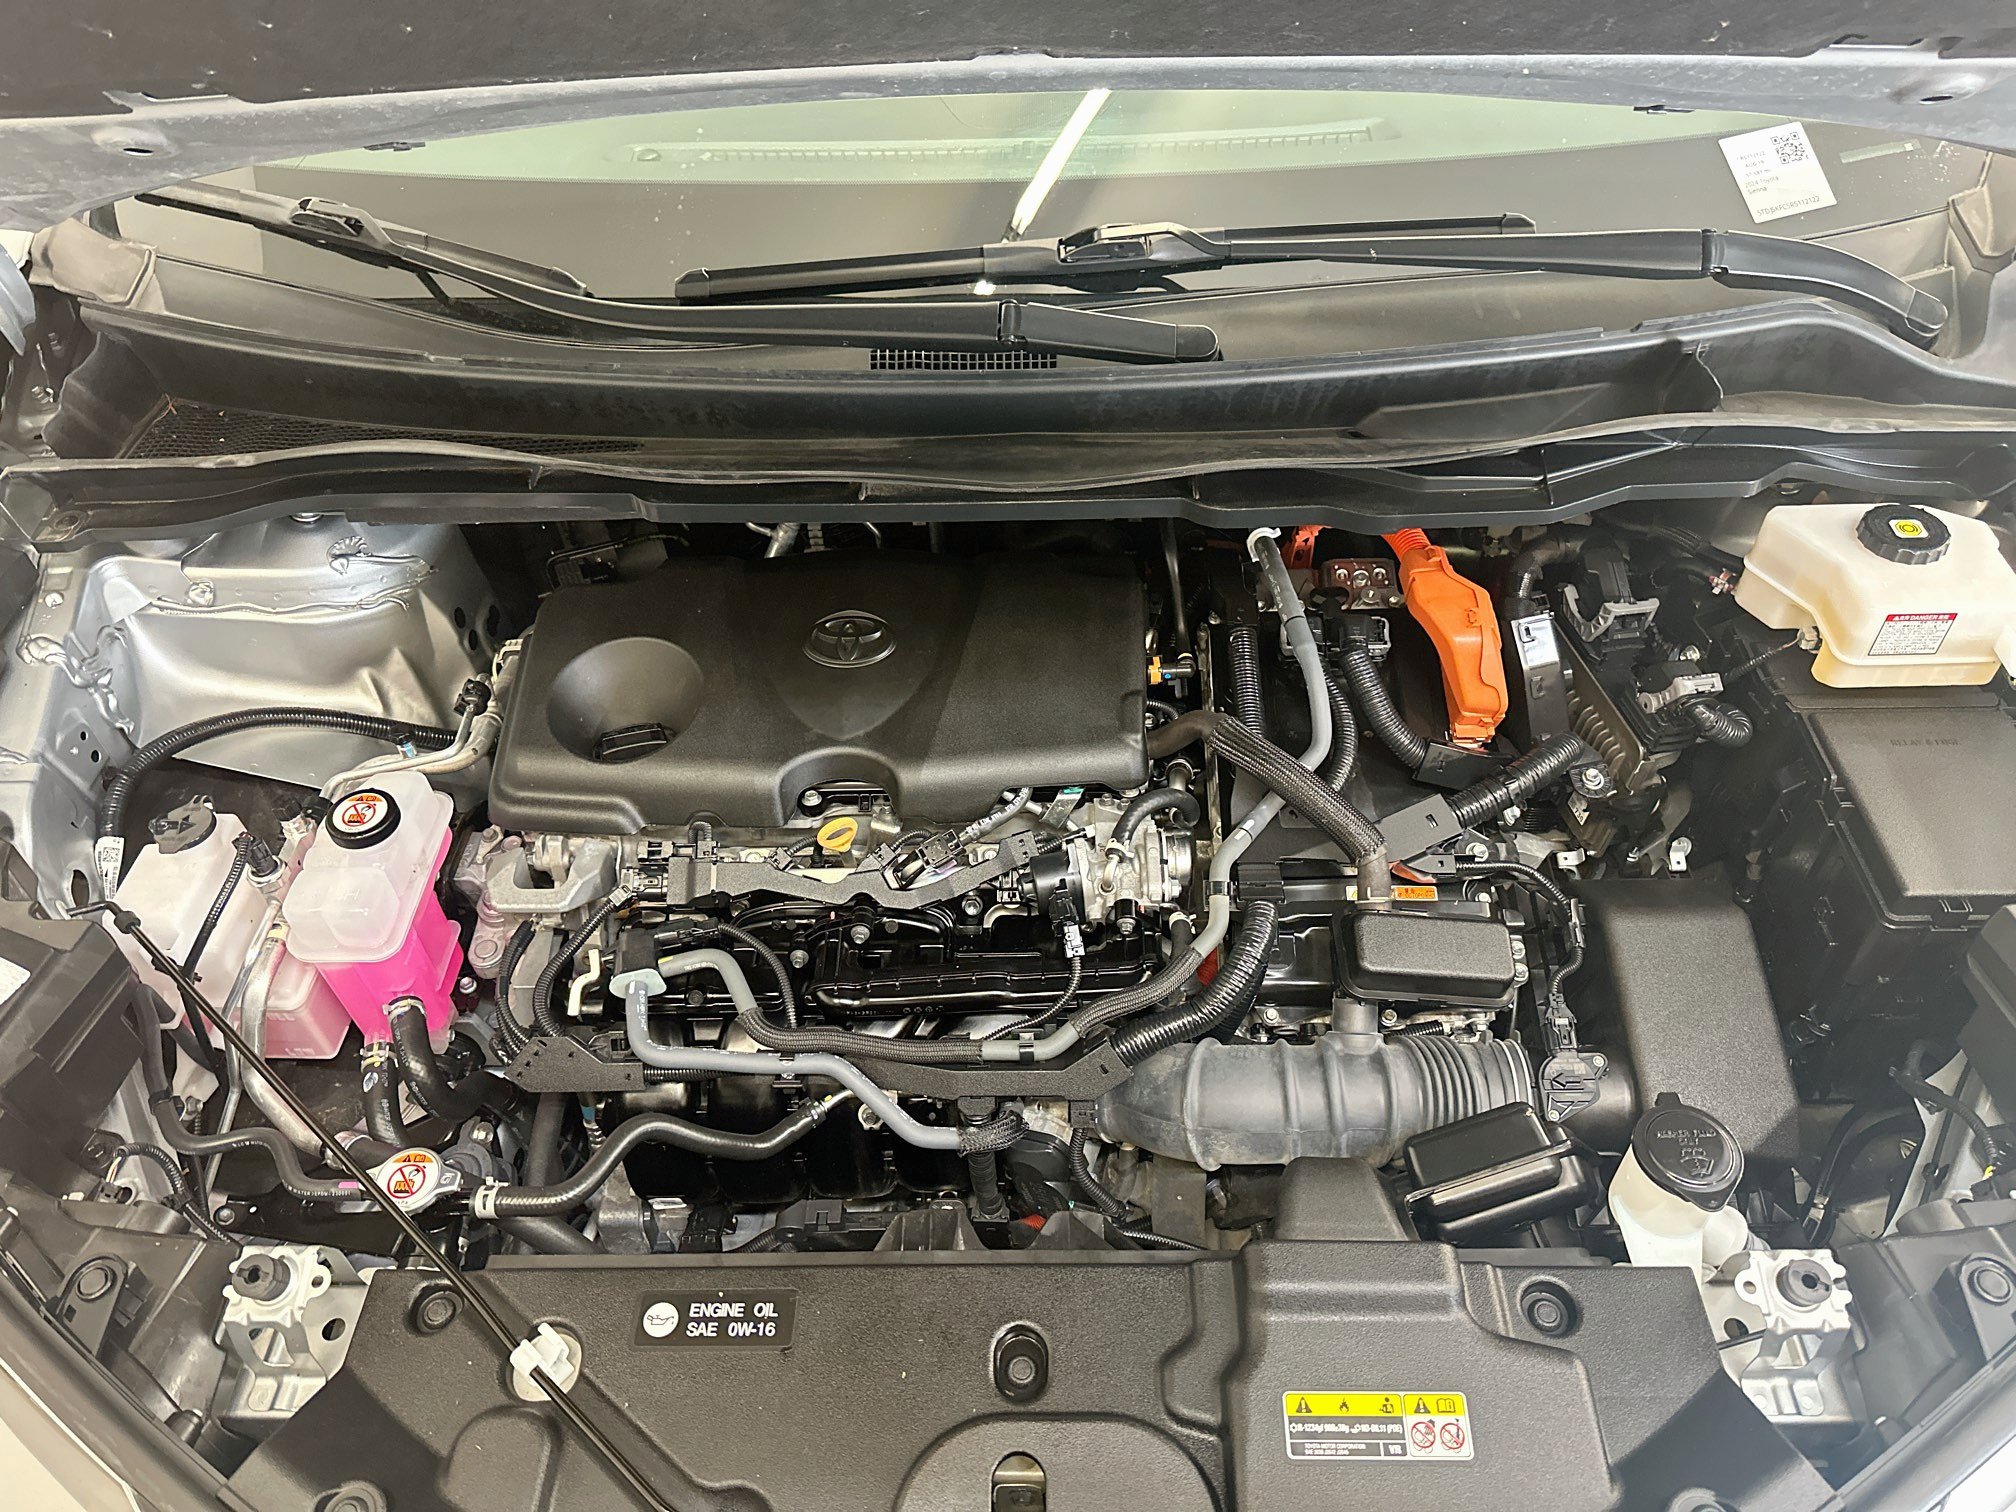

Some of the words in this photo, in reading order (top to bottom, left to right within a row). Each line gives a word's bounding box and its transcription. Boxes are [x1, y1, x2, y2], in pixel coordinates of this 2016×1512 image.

[1747, 186, 1768, 195] Sienna
[689, 1302, 745, 1317] ENGINE
[753, 1302, 778, 1318] OIL
[685, 1321, 718, 1337] SAE
[727, 1321, 776, 1337] 0W-16
